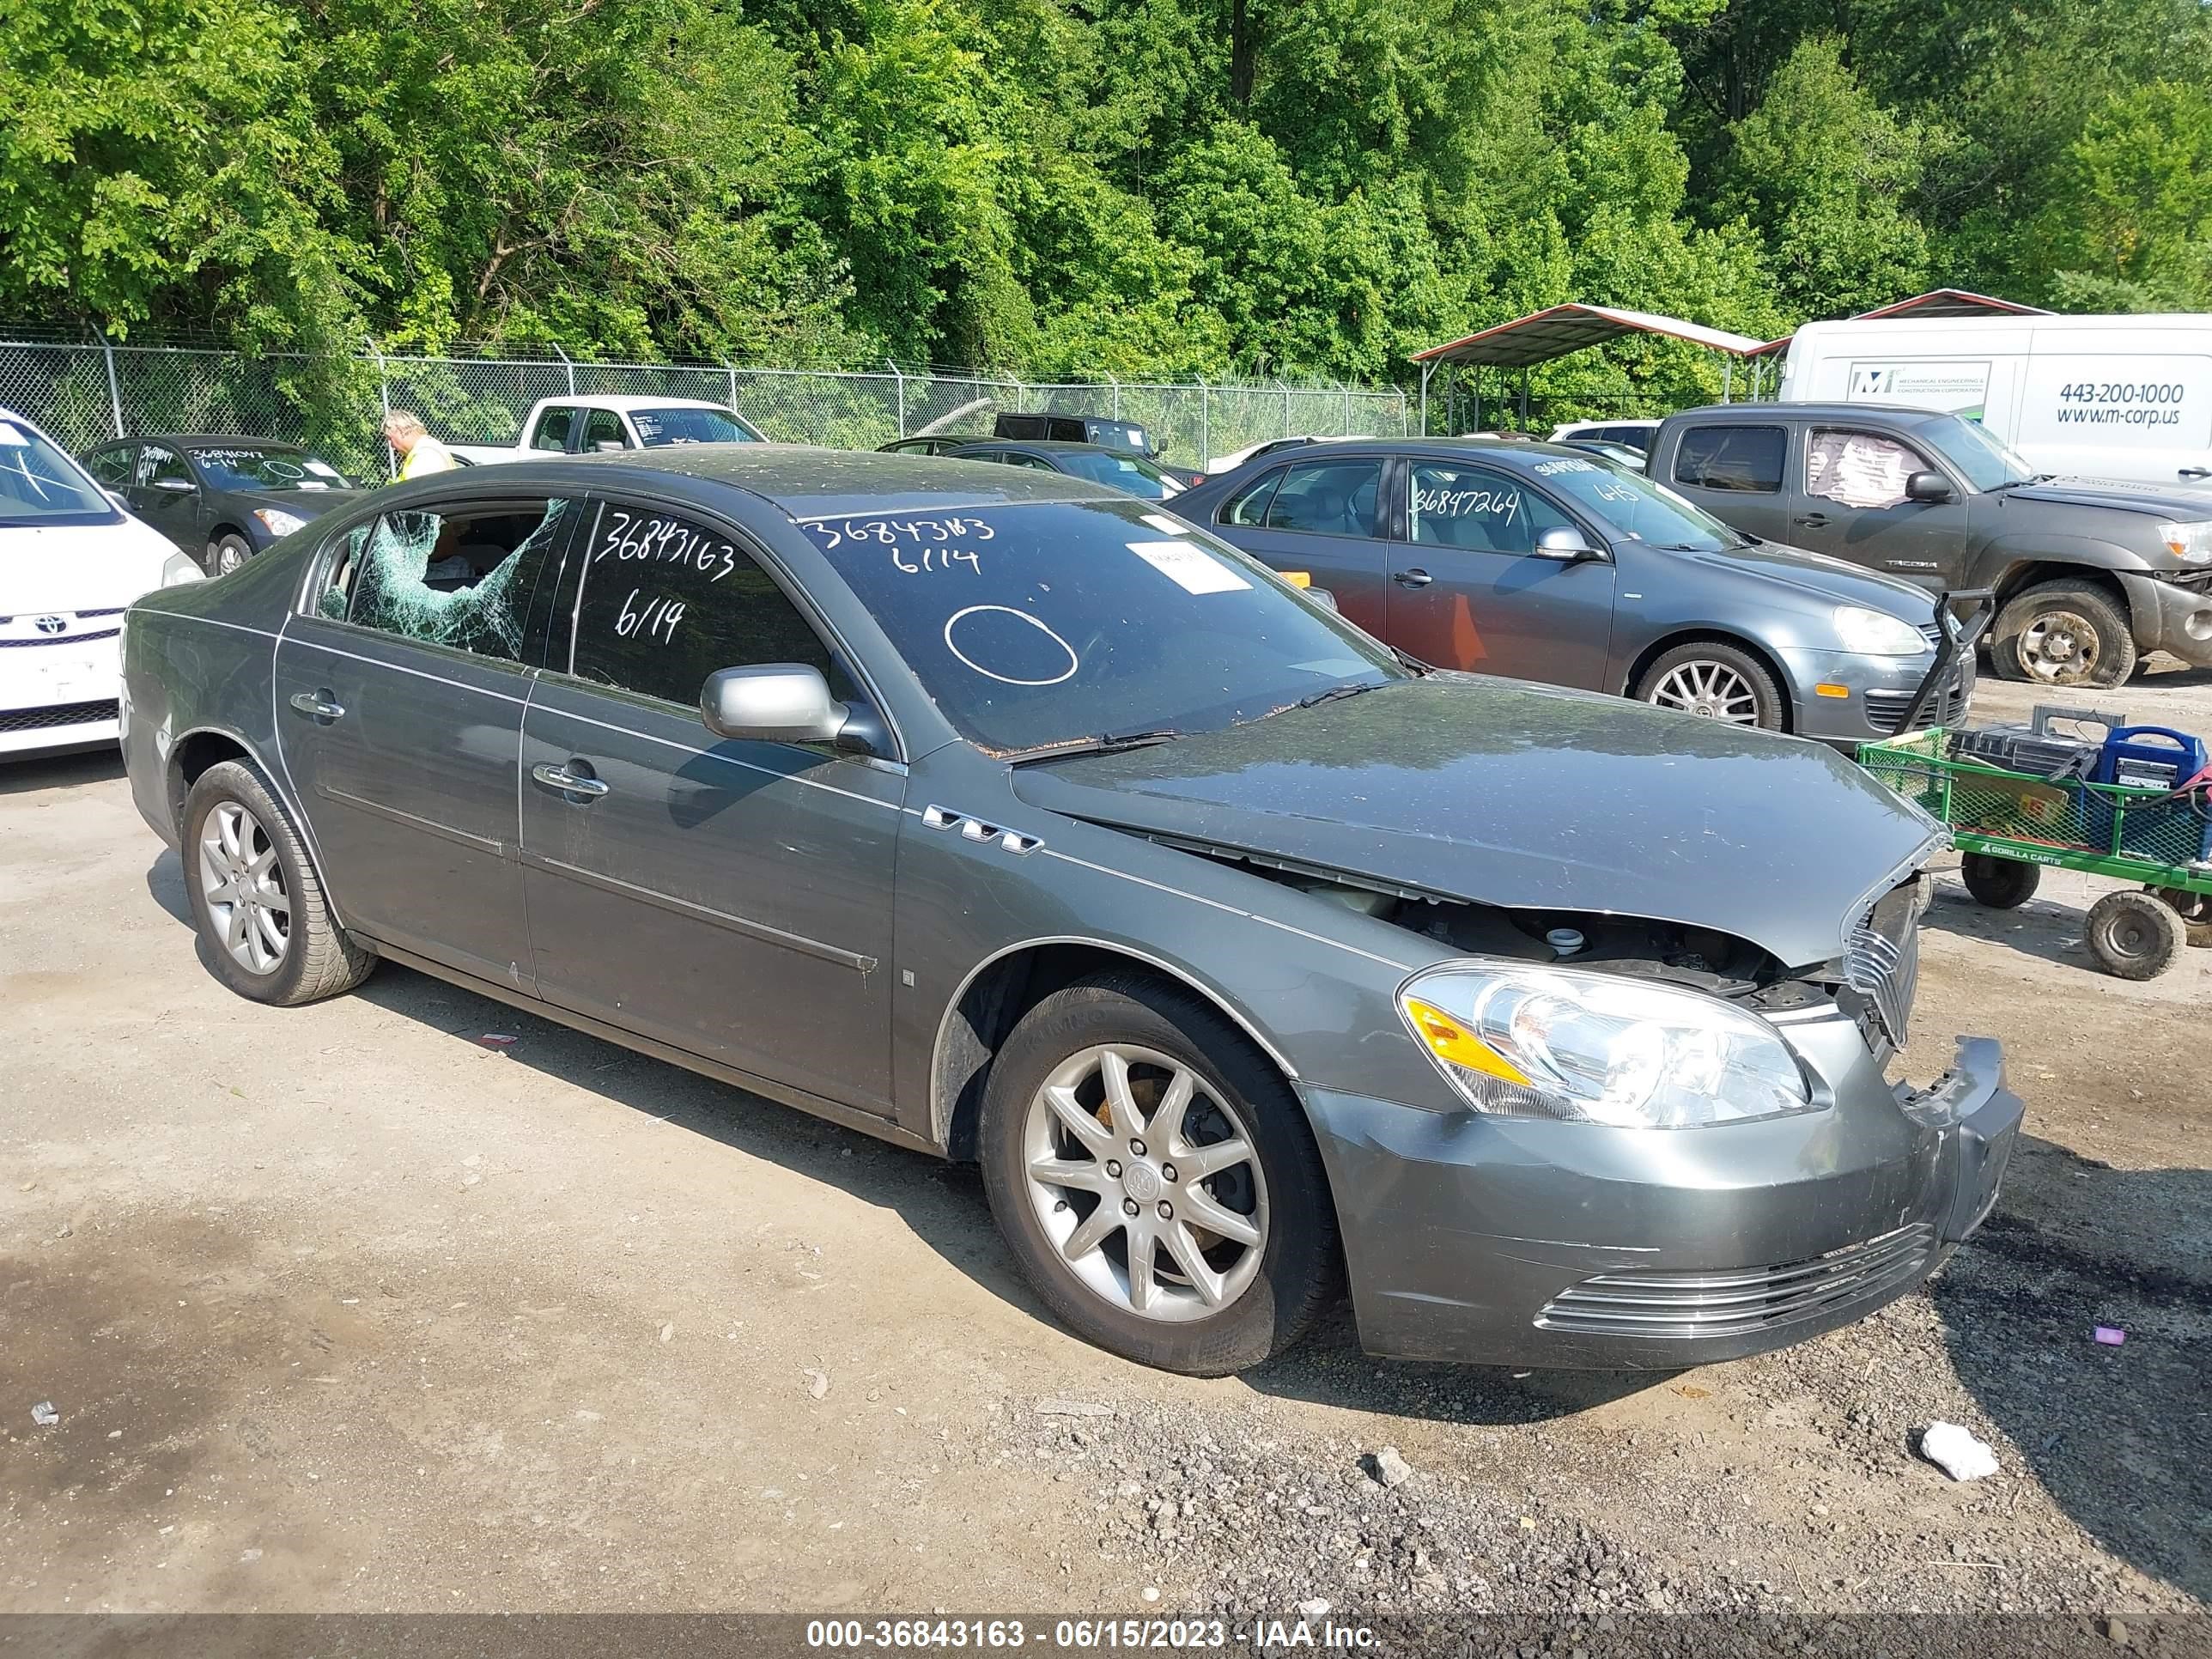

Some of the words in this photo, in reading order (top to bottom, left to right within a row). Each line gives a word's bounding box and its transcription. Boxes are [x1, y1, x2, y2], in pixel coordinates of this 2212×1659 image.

[2060, 384, 2184, 404] 443-200-1000
[2057, 409, 2180, 429] www.m-corp.us
[201, 459, 238, 469] 6-14
[1409, 489, 1520, 528] 36847264
[594, 513, 735, 582] 36843163
[615, 588, 686, 646] 6/14
[1991, 846, 2028, 860] GORILLA
[2030, 854, 2062, 866] CARTS
